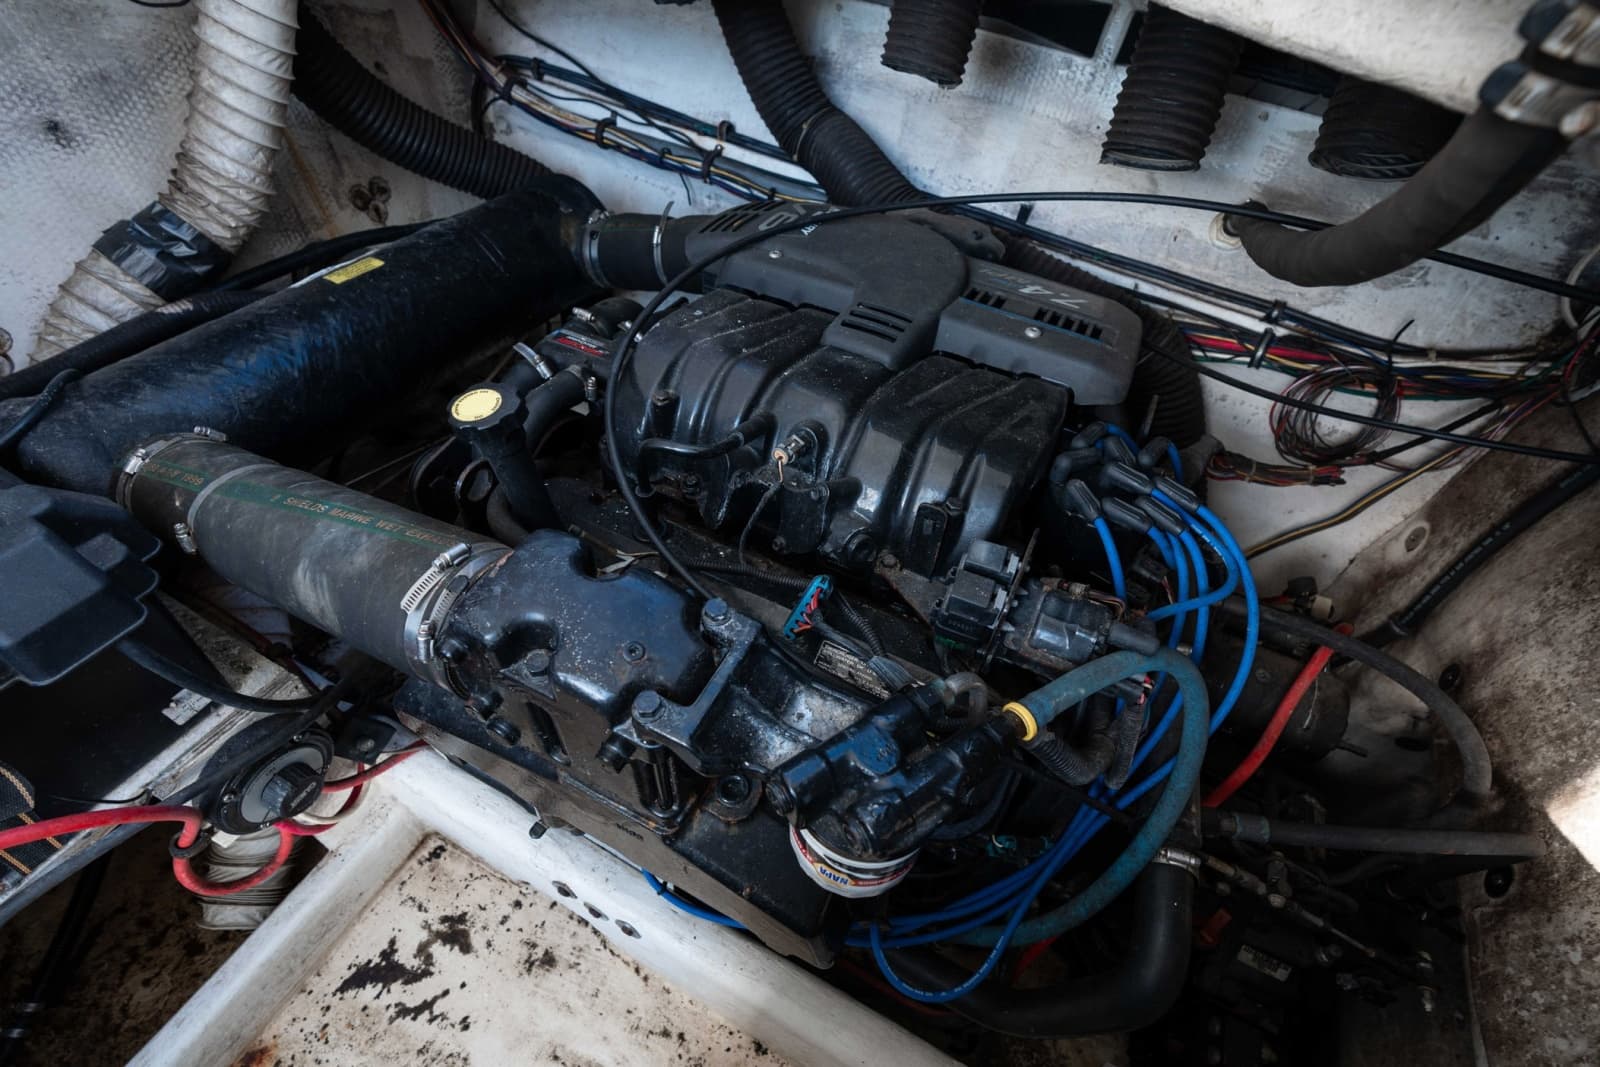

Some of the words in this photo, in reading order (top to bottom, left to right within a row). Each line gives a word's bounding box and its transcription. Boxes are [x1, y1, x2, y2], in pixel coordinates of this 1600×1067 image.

[328, 507, 373, 525] MARINE
[375, 519, 402, 533] WET
[819, 866, 849, 885] NAPA
